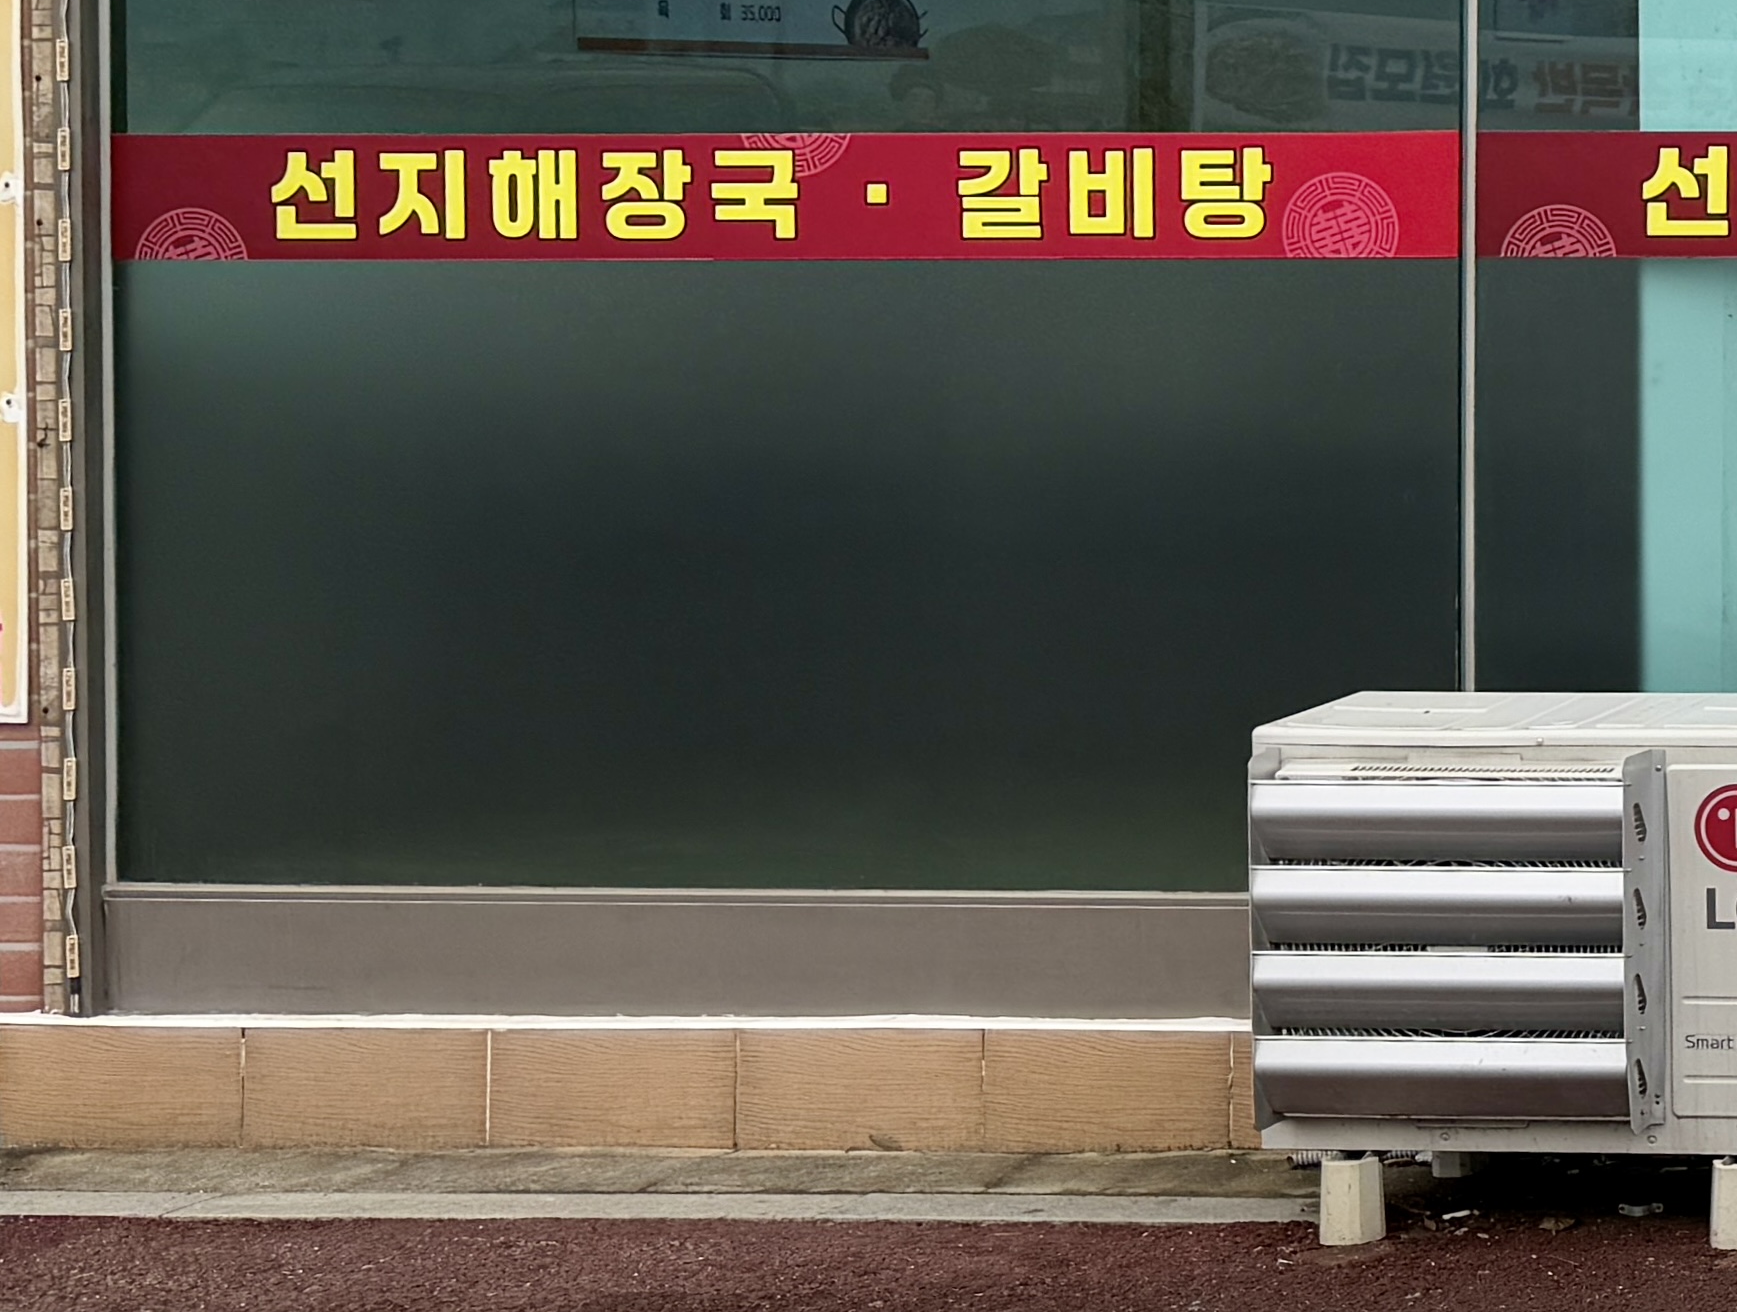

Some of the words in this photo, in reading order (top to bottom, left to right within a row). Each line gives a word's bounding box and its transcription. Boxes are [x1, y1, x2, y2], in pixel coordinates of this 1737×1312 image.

[272, 148, 802, 240] 선지해장국
[957, 147, 1273, 239] 갈비탕
[1685, 1034, 1734, 1050] Smart
